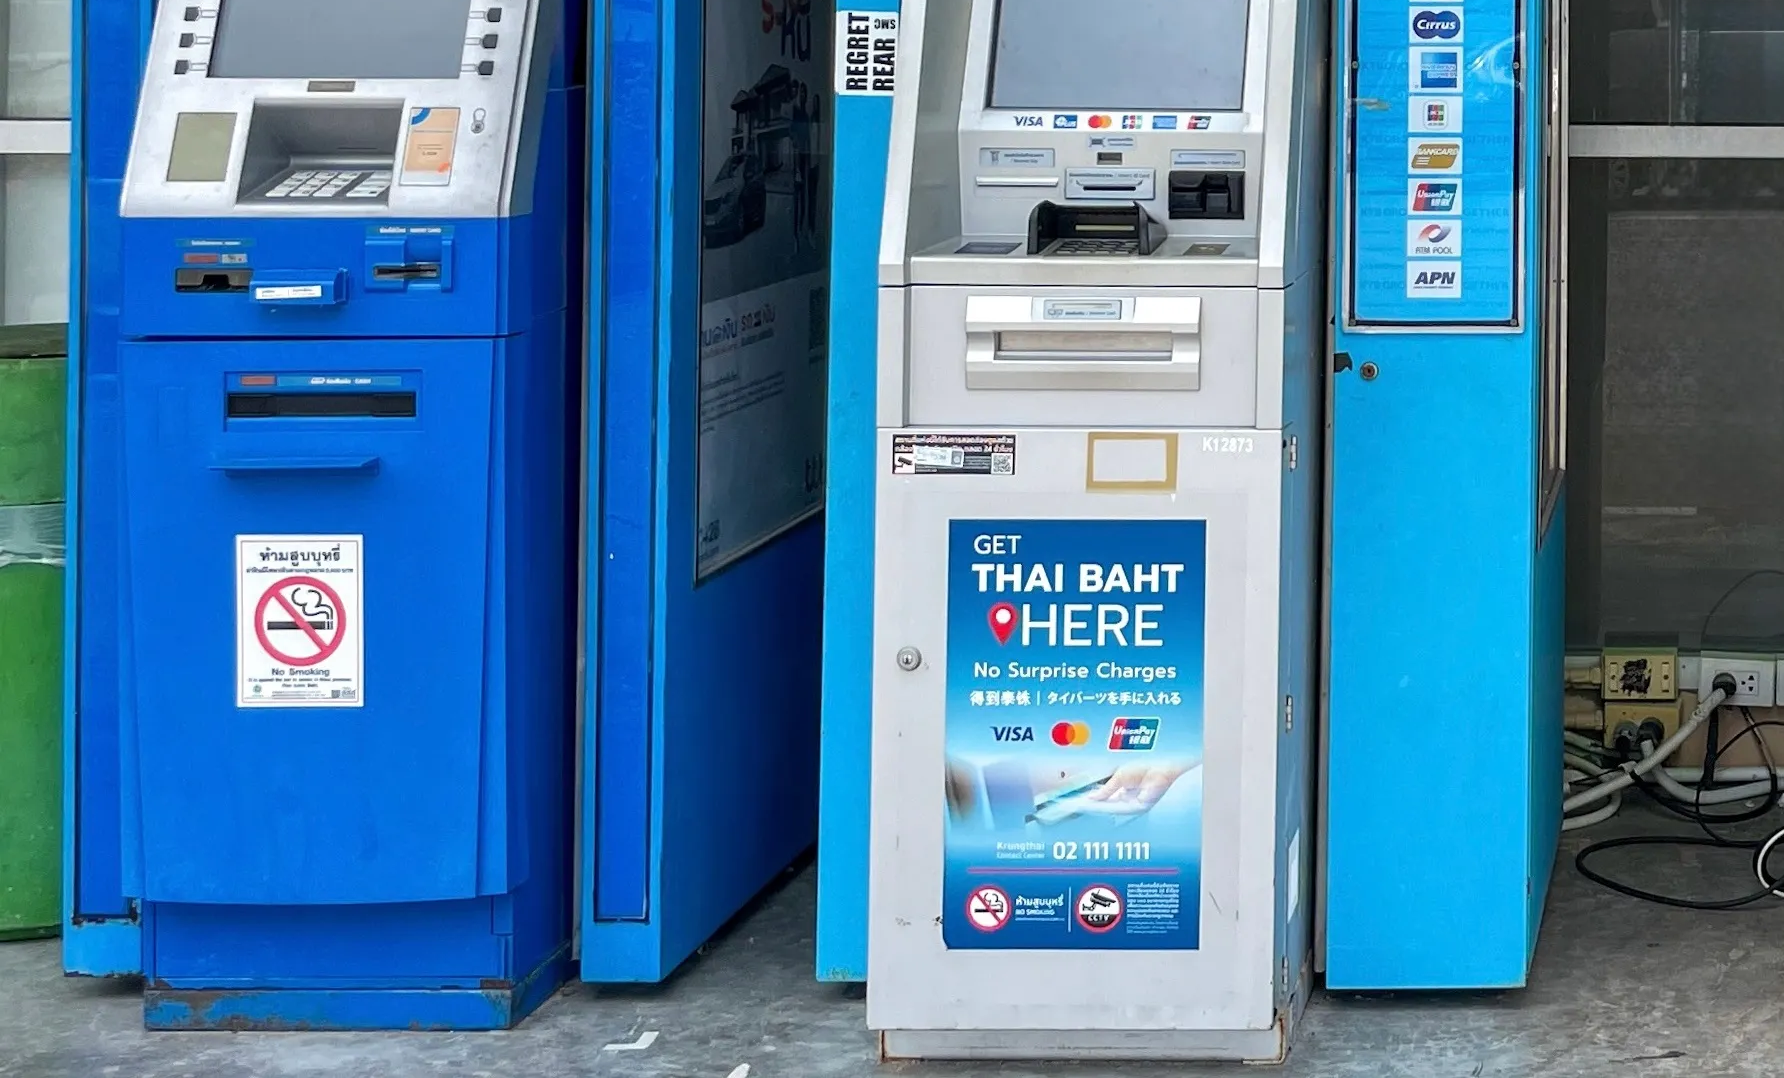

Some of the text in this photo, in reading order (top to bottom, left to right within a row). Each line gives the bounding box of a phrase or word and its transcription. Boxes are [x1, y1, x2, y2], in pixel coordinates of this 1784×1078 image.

[1416, 19, 1456, 31] Cirrus
[845, 12, 870, 91] REGRET
[872, 38, 896, 91] REAR
[1013, 115, 1044, 127] VISA
[1414, 271, 1456, 285] APN
[259, 542, 342, 567] ห้ามสูบบุหรี่
[973, 534, 1022, 555] GET
[971, 563, 1185, 593] THAI BAHT
[1020, 603, 1164, 647] HERE
[973, 661, 1177, 683] No Surprise Charges
[989, 726, 1034, 742] VISA
[997, 841, 1150, 860] Krungthai 02 111 1111
[1087, 914, 1110, 922] CCTV
